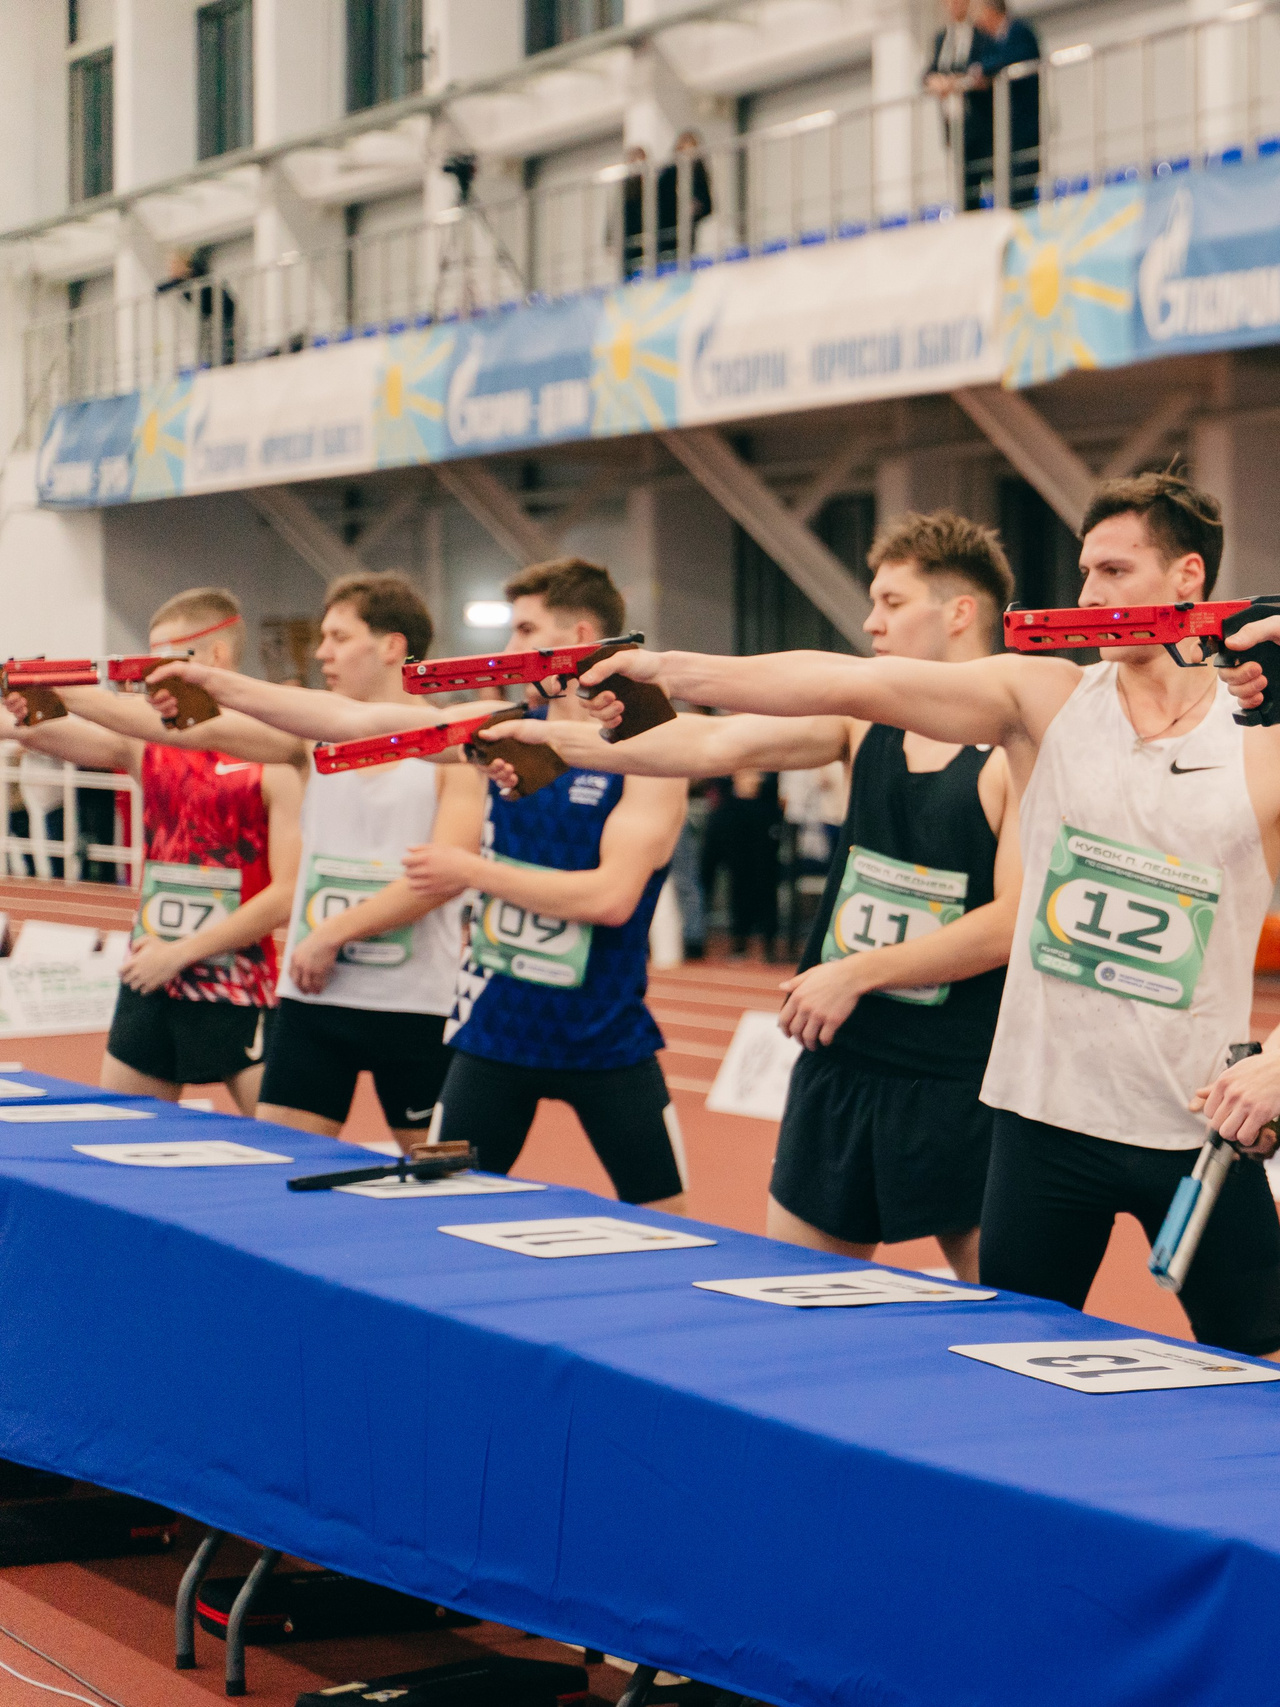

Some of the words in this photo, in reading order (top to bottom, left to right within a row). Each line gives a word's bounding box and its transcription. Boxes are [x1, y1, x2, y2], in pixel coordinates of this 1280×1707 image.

[1075, 841, 1122, 862] КУБОК
[1142, 861, 1209, 887] ЛЕДНЕВА
[159, 900, 214, 931] 07
[853, 904, 909, 947] 11
[1075, 891, 1170, 955] 12
[1026, 1354, 1174, 1379] 13
